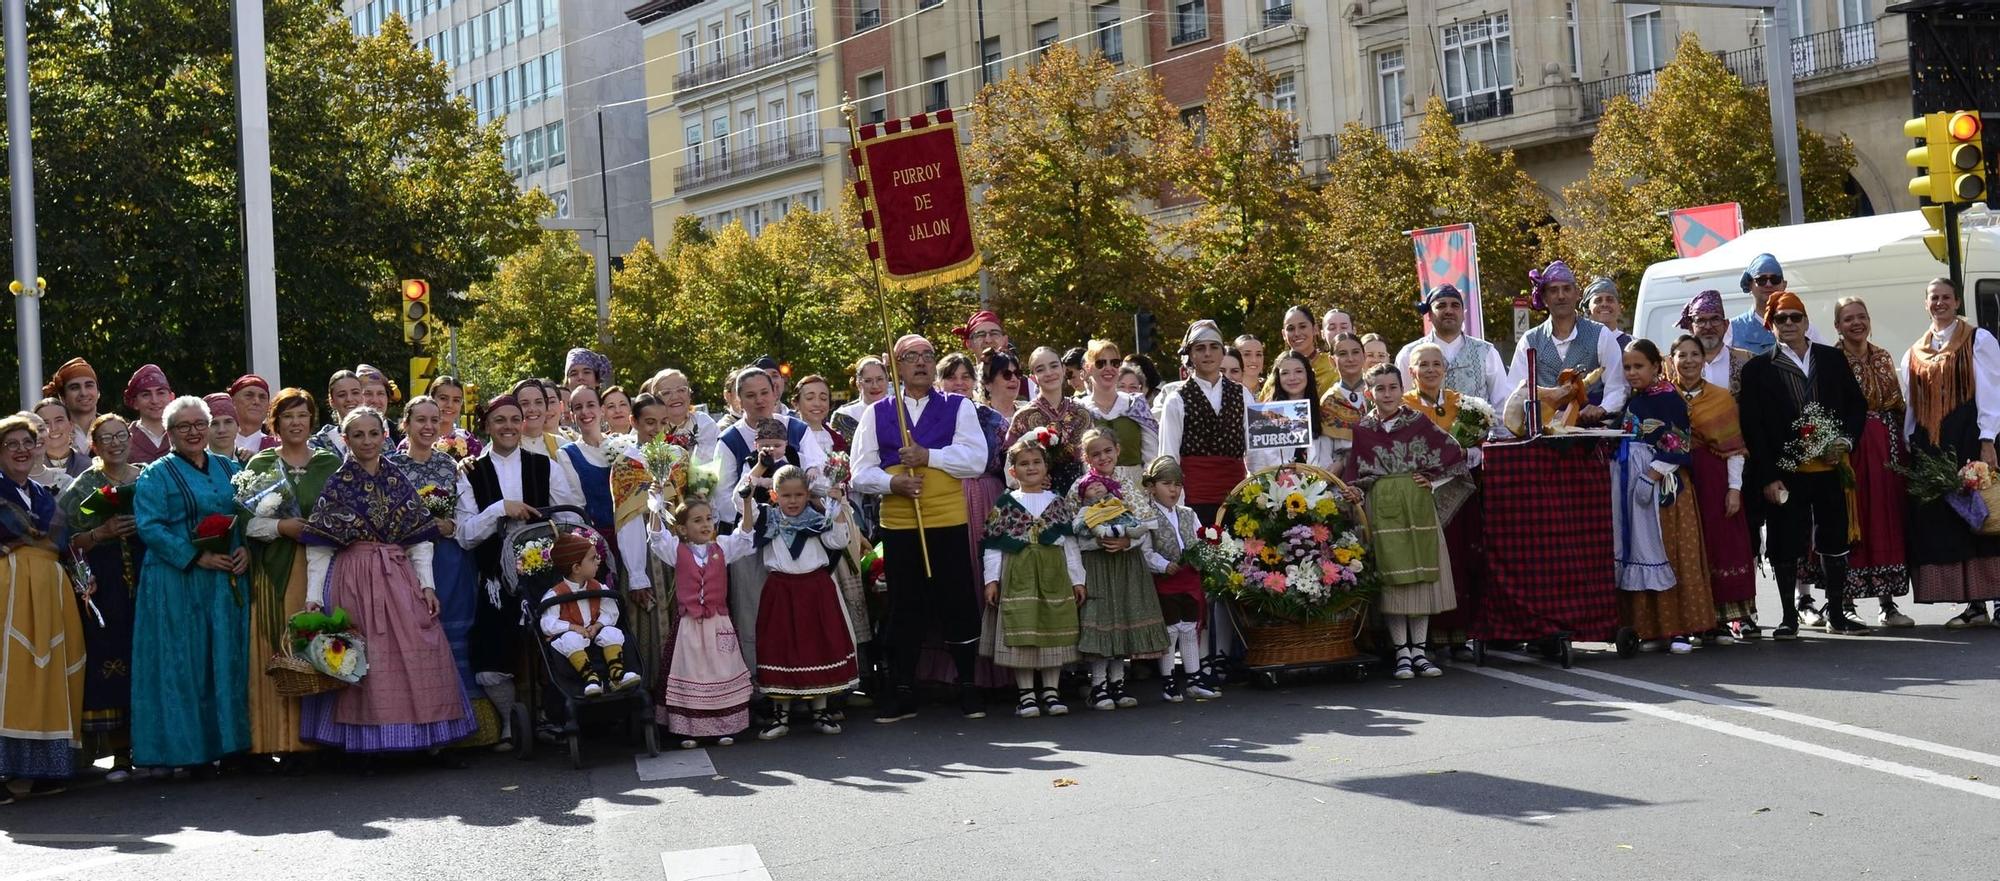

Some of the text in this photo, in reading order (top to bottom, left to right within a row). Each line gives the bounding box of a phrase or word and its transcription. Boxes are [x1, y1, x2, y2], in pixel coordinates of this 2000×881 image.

[892, 162, 941, 186] PURROY
[913, 193, 933, 211] DE
[908, 218, 950, 241] JALON
[1252, 429, 1307, 446] PURROY
